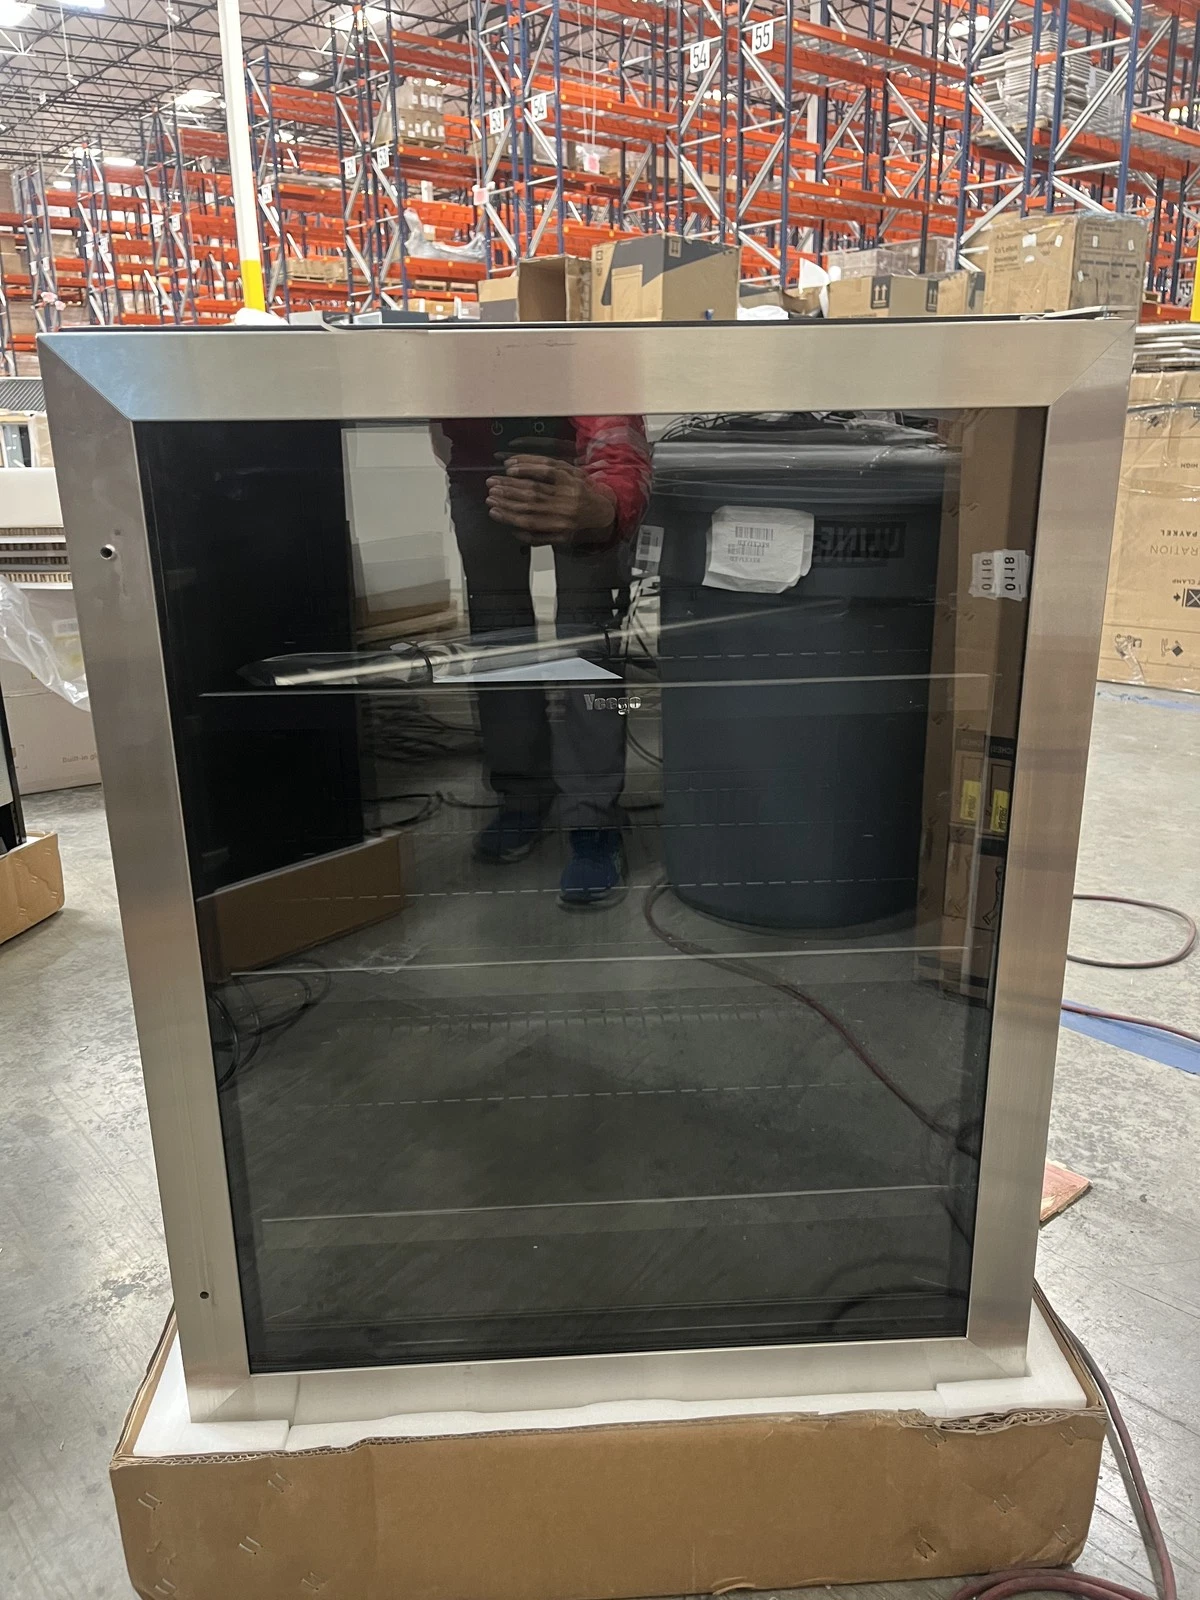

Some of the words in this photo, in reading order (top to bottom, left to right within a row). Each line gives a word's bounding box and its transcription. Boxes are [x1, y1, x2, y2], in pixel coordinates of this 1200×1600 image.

[755, 23, 770, 50] 55
[693, 43, 706, 69] 54
[1160, 528, 1198, 538] PAYKEL
